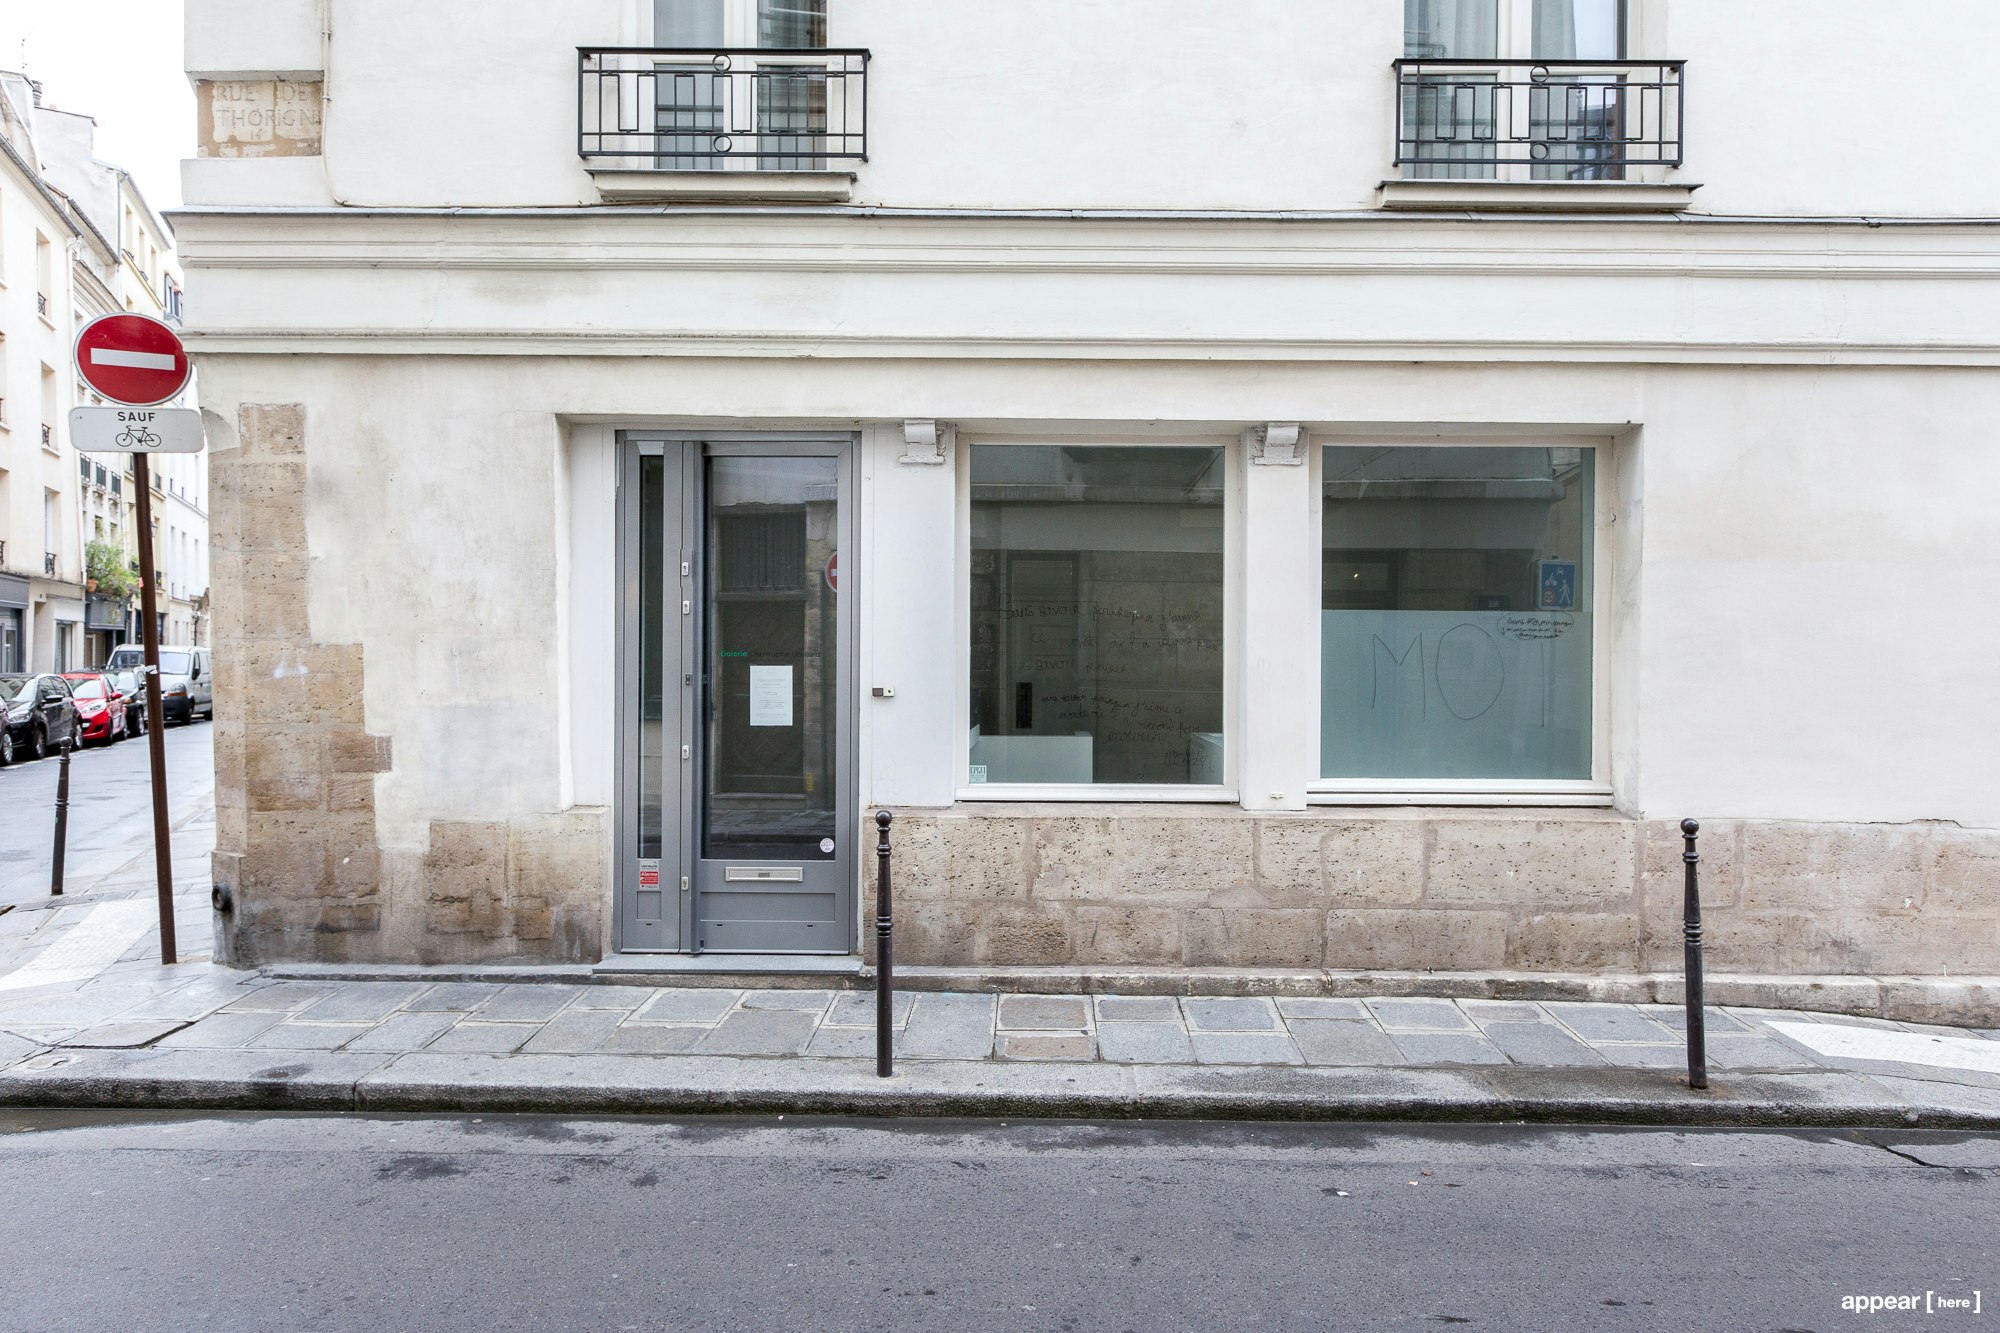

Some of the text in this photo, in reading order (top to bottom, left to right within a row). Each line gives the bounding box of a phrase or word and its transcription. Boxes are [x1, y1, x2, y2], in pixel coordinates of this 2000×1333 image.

[216, 84, 308, 102] RUE DE
[215, 109, 321, 127] THORIGN
[117, 411, 156, 422] SAUF
[720, 649, 748, 657] Galerie
